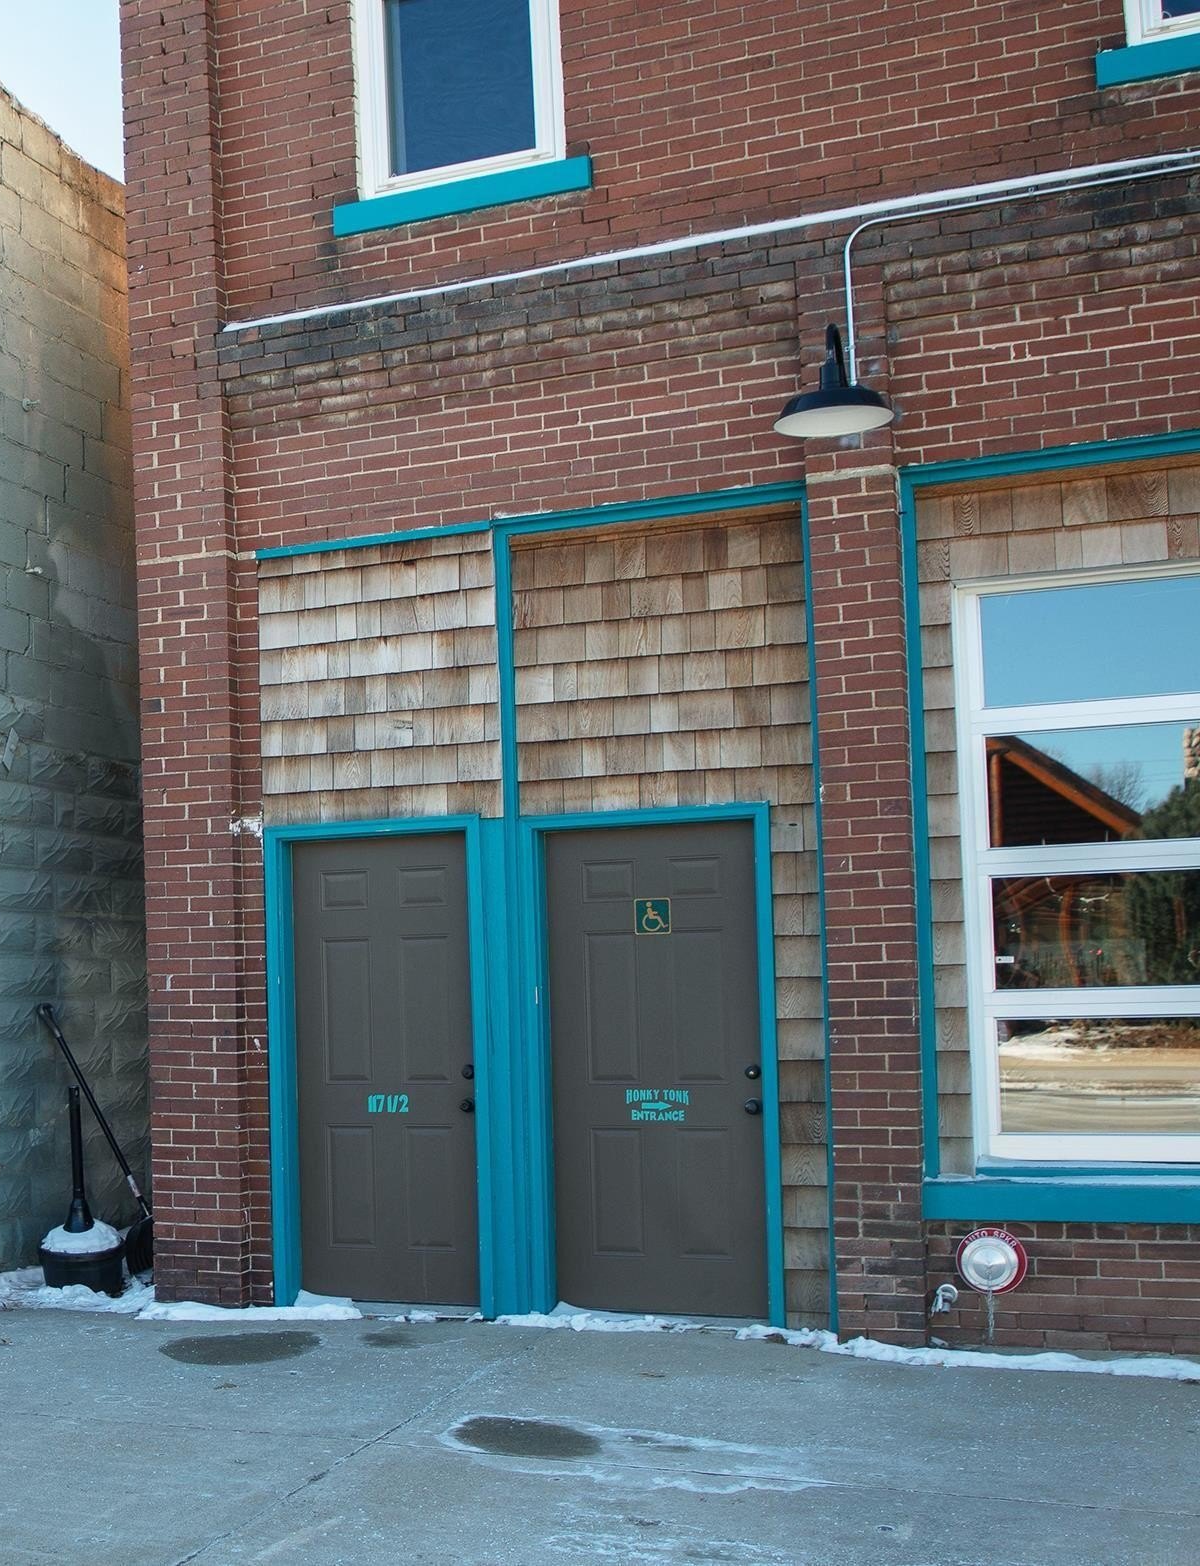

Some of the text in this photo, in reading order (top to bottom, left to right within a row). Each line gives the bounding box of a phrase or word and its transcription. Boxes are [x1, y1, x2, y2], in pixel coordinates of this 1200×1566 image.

[368, 1094, 385, 1112] 117
[625, 1088, 689, 1105] HONKY TONK
[631, 1109, 685, 1121] ENTRANCE
